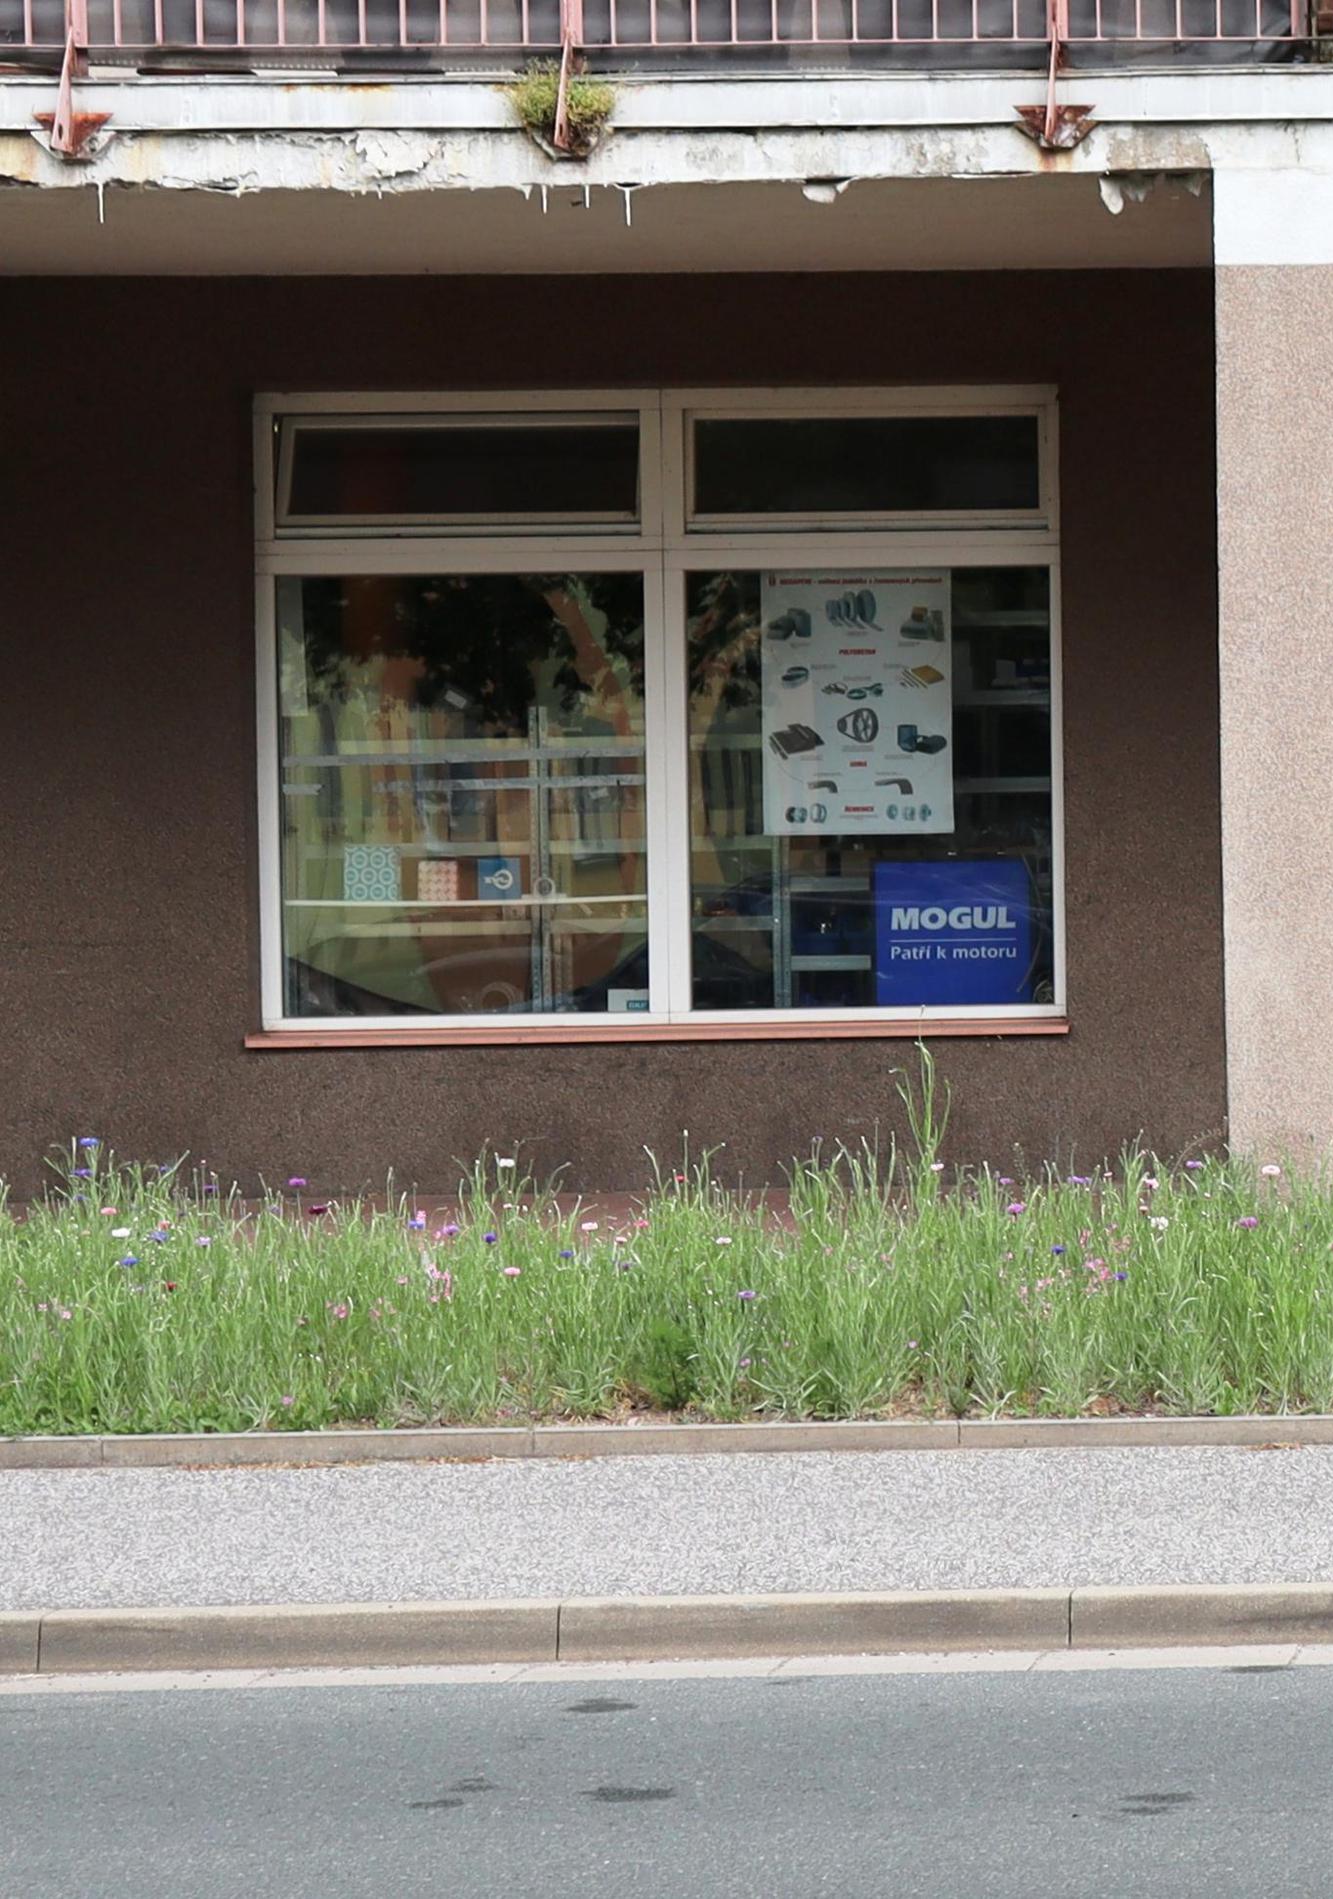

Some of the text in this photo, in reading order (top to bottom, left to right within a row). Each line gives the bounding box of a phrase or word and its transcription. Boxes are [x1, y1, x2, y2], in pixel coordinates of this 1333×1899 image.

[890, 906, 1017, 931] MOGUL
[890, 945, 1017, 960] Patří k motoru
